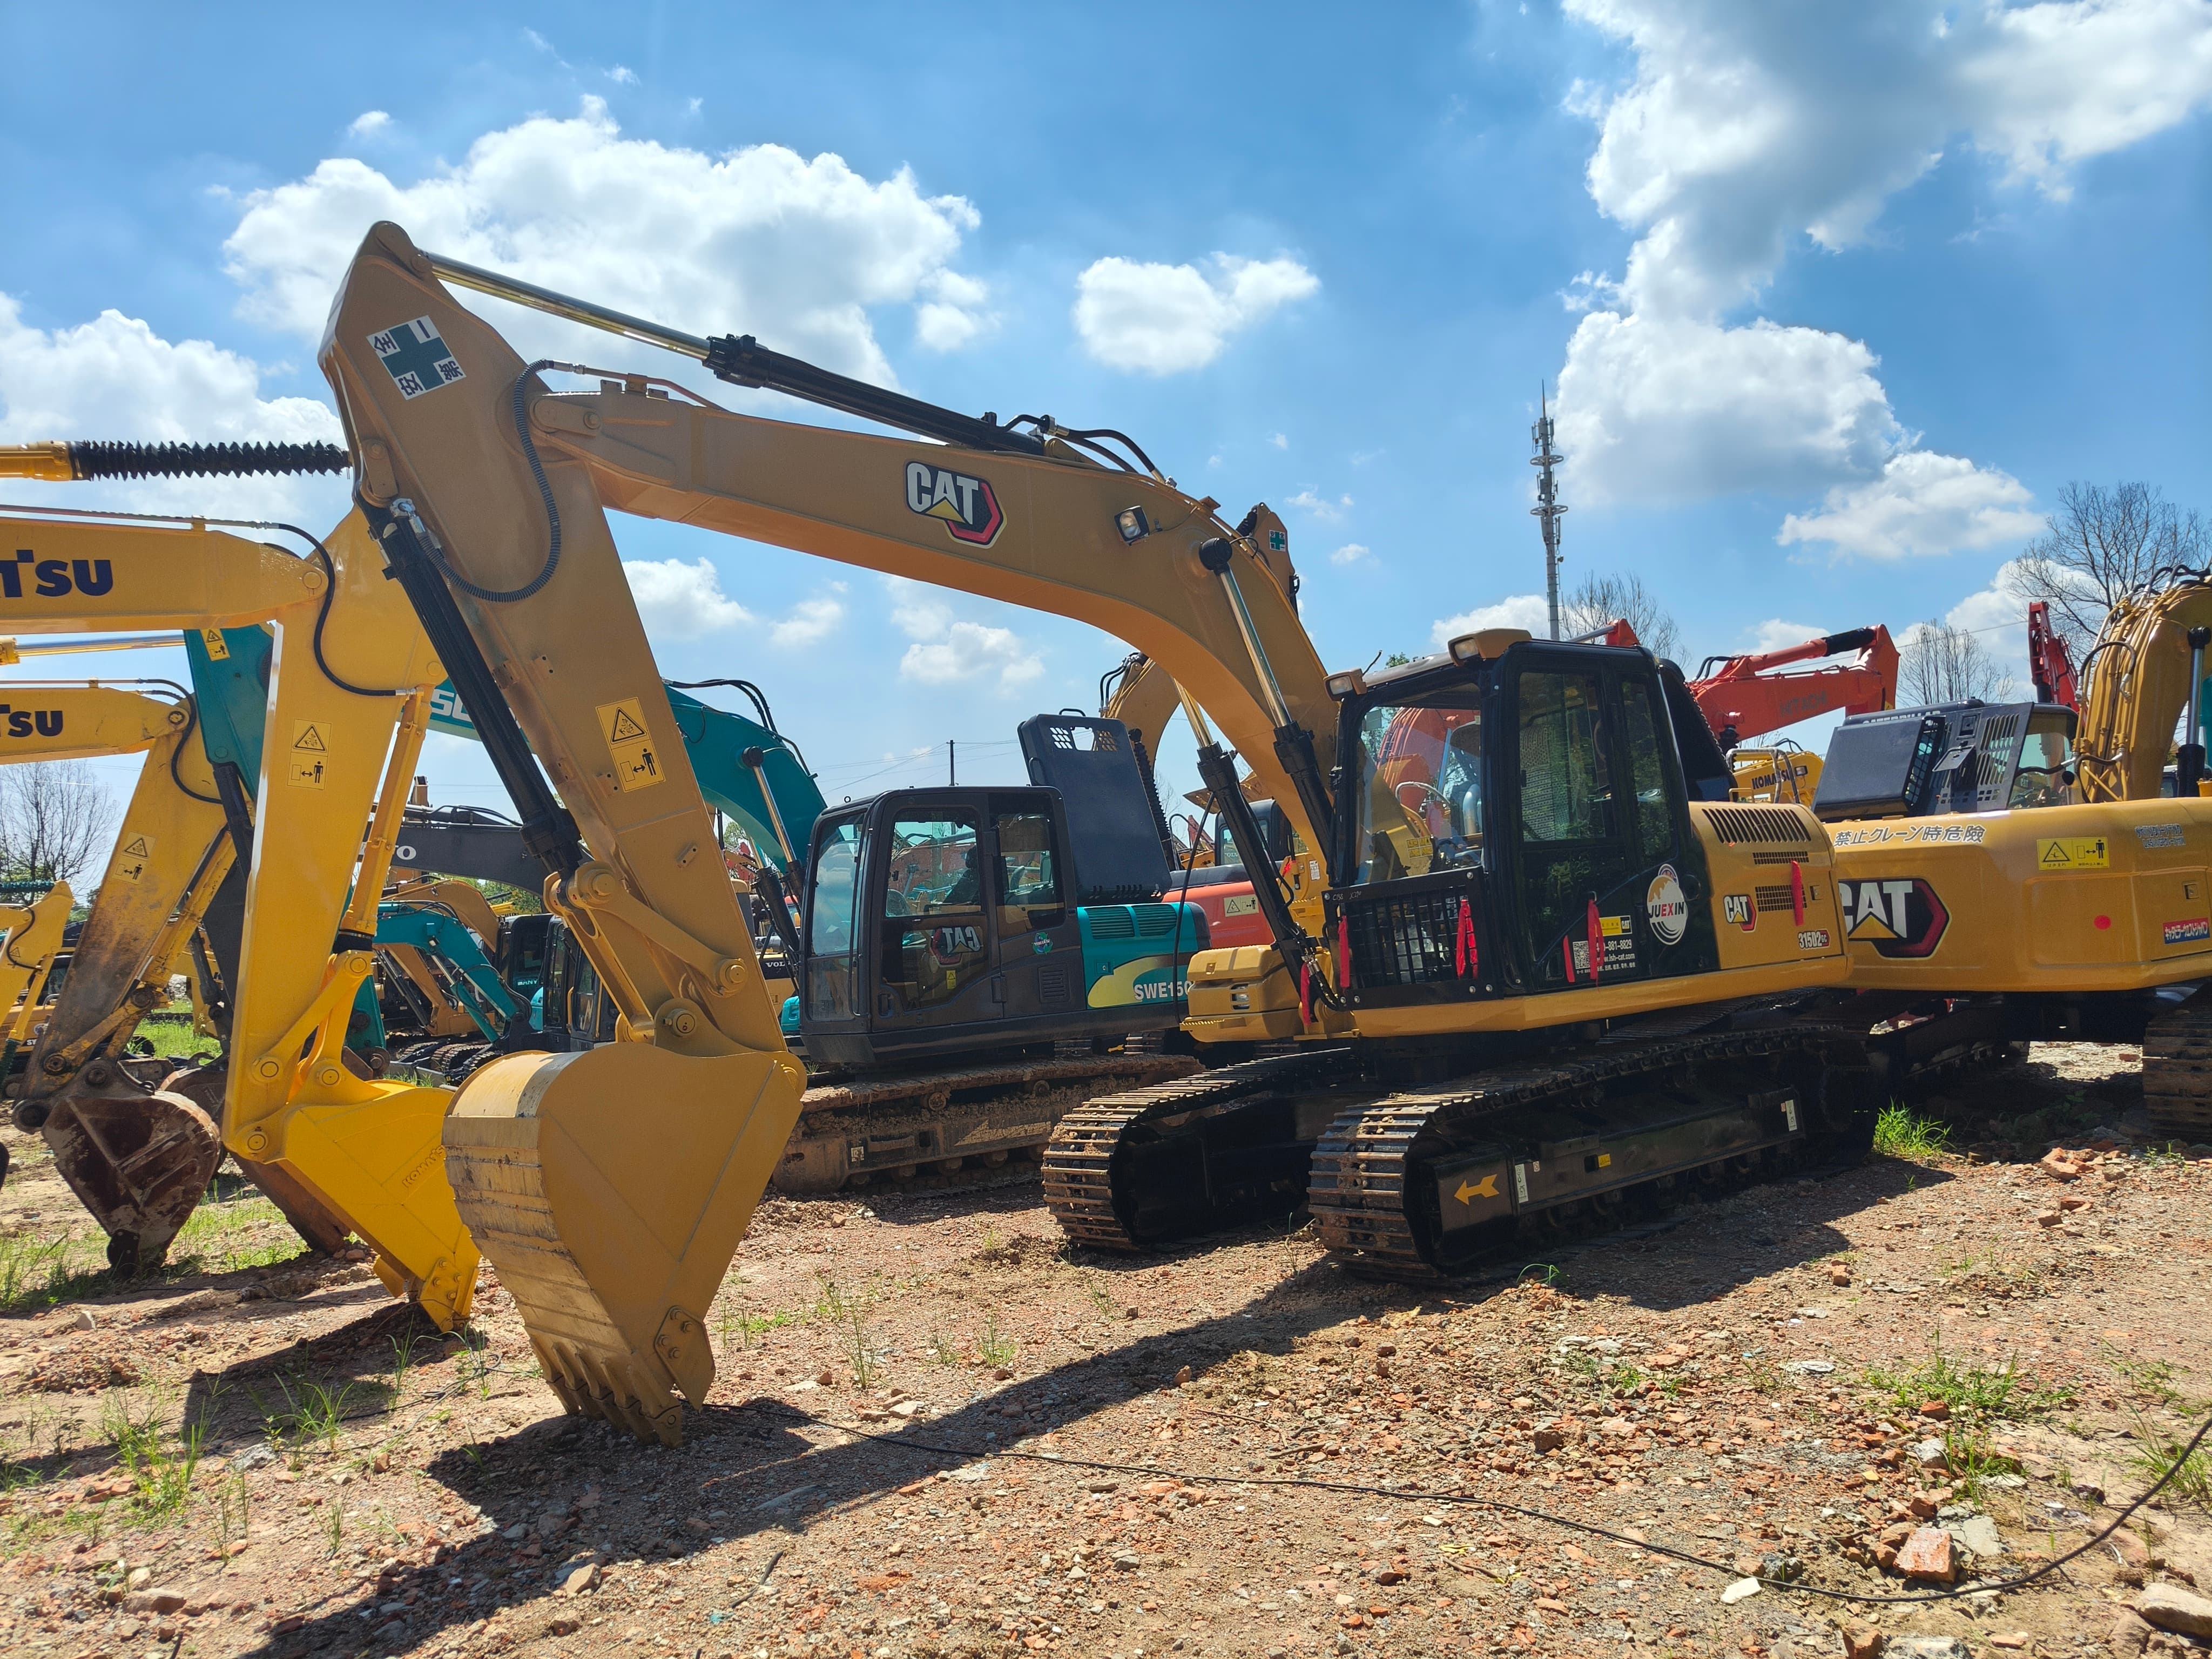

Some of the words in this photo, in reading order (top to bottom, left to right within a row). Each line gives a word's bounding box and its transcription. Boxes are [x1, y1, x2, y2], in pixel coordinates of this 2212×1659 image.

[907, 463, 979, 525] CAT
[1752, 769, 1791, 790] KOMAS
[1648, 901, 1684, 919] JUEXIN
[1724, 896, 1748, 923] CAT
[1838, 880, 1913, 939] CAT
[1798, 932, 1823, 949] 315D2
[402, 1144, 446, 1189] KOMATS
